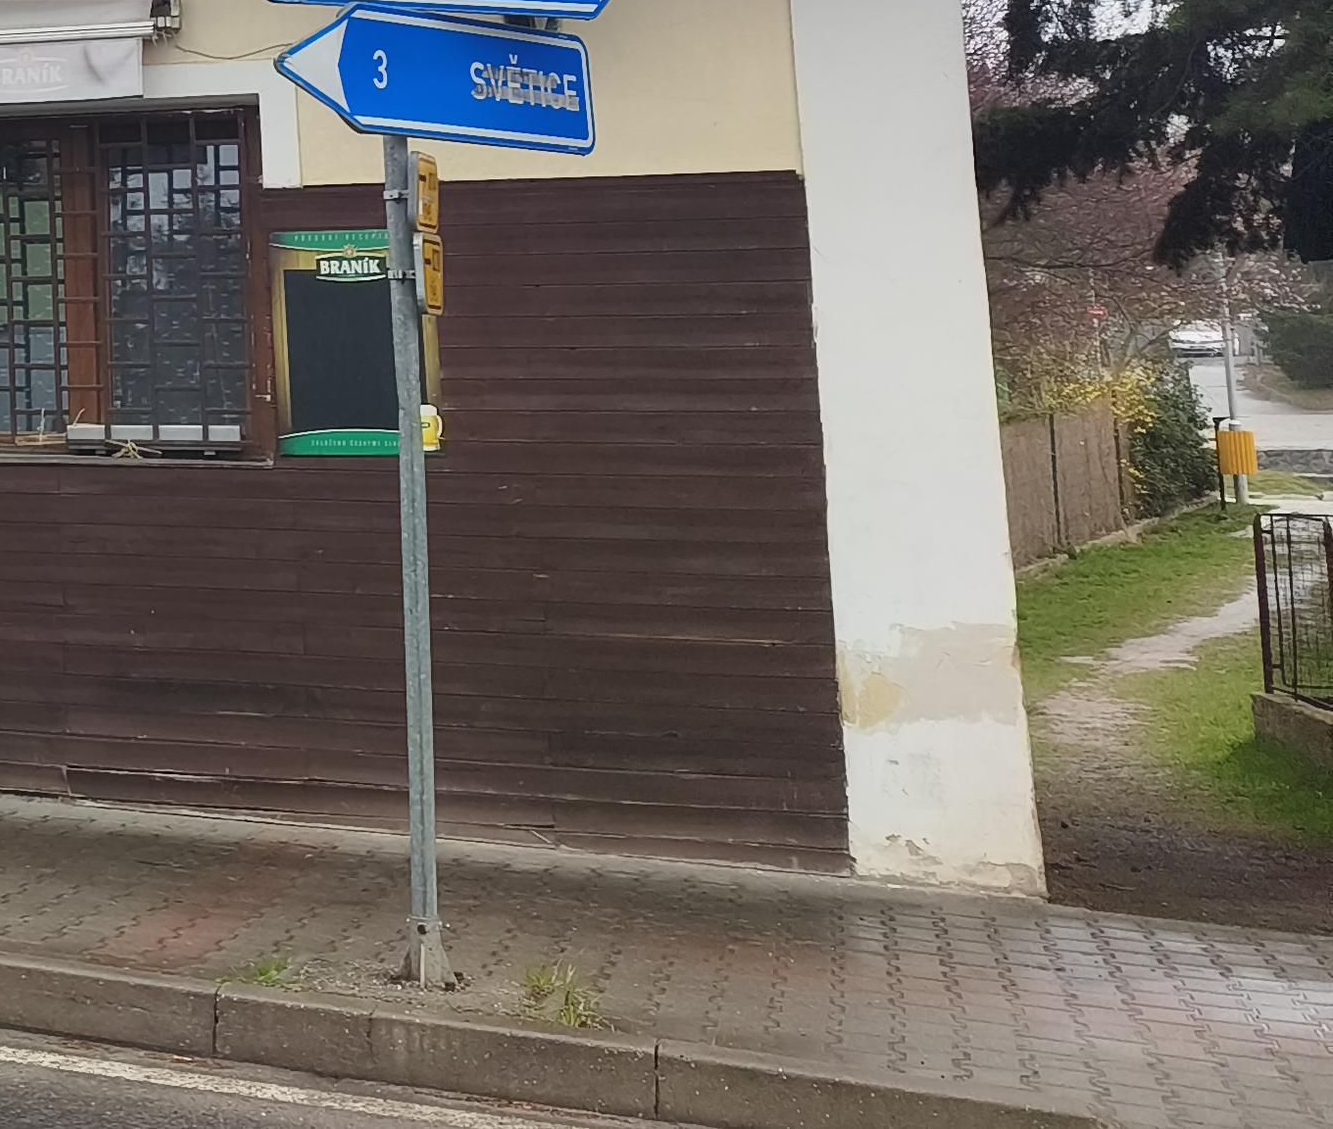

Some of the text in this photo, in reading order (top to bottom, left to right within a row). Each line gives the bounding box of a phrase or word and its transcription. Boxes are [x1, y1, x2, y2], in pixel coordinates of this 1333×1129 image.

[372, 49, 580, 112] 3 SVĚTICE
[319, 257, 381, 275] BRANÍK
